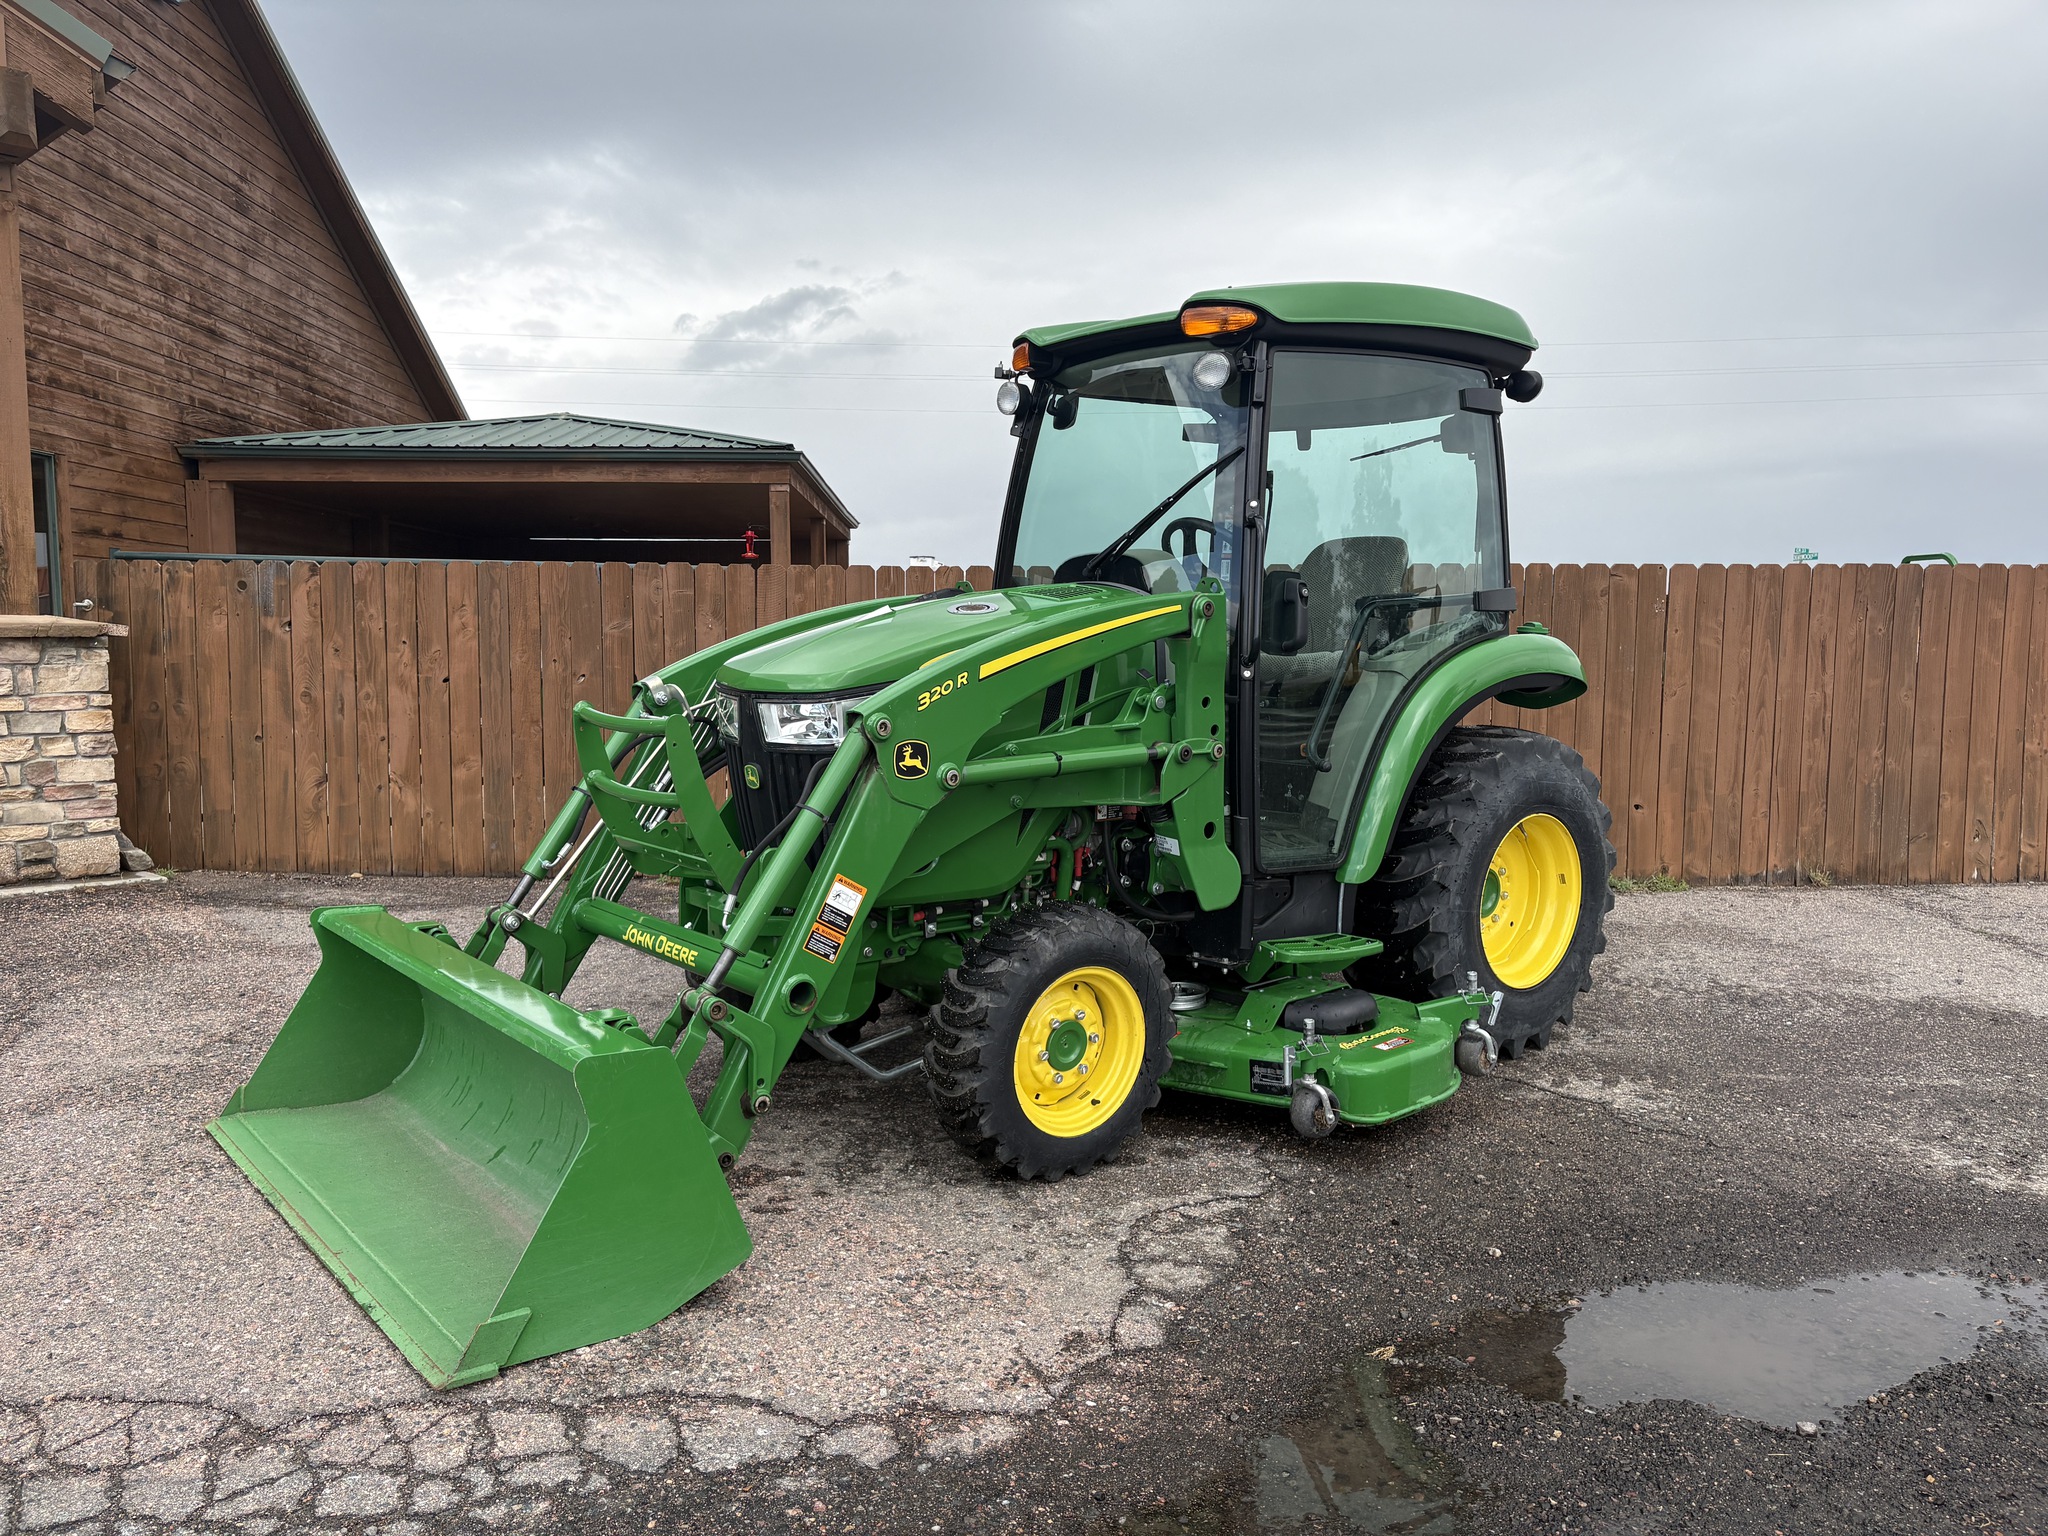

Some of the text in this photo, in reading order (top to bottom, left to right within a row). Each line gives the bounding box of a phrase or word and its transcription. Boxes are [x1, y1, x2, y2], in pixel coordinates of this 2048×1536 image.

[917, 671, 968, 712] 320 R
[622, 924, 698, 967] JOHN DEERE
